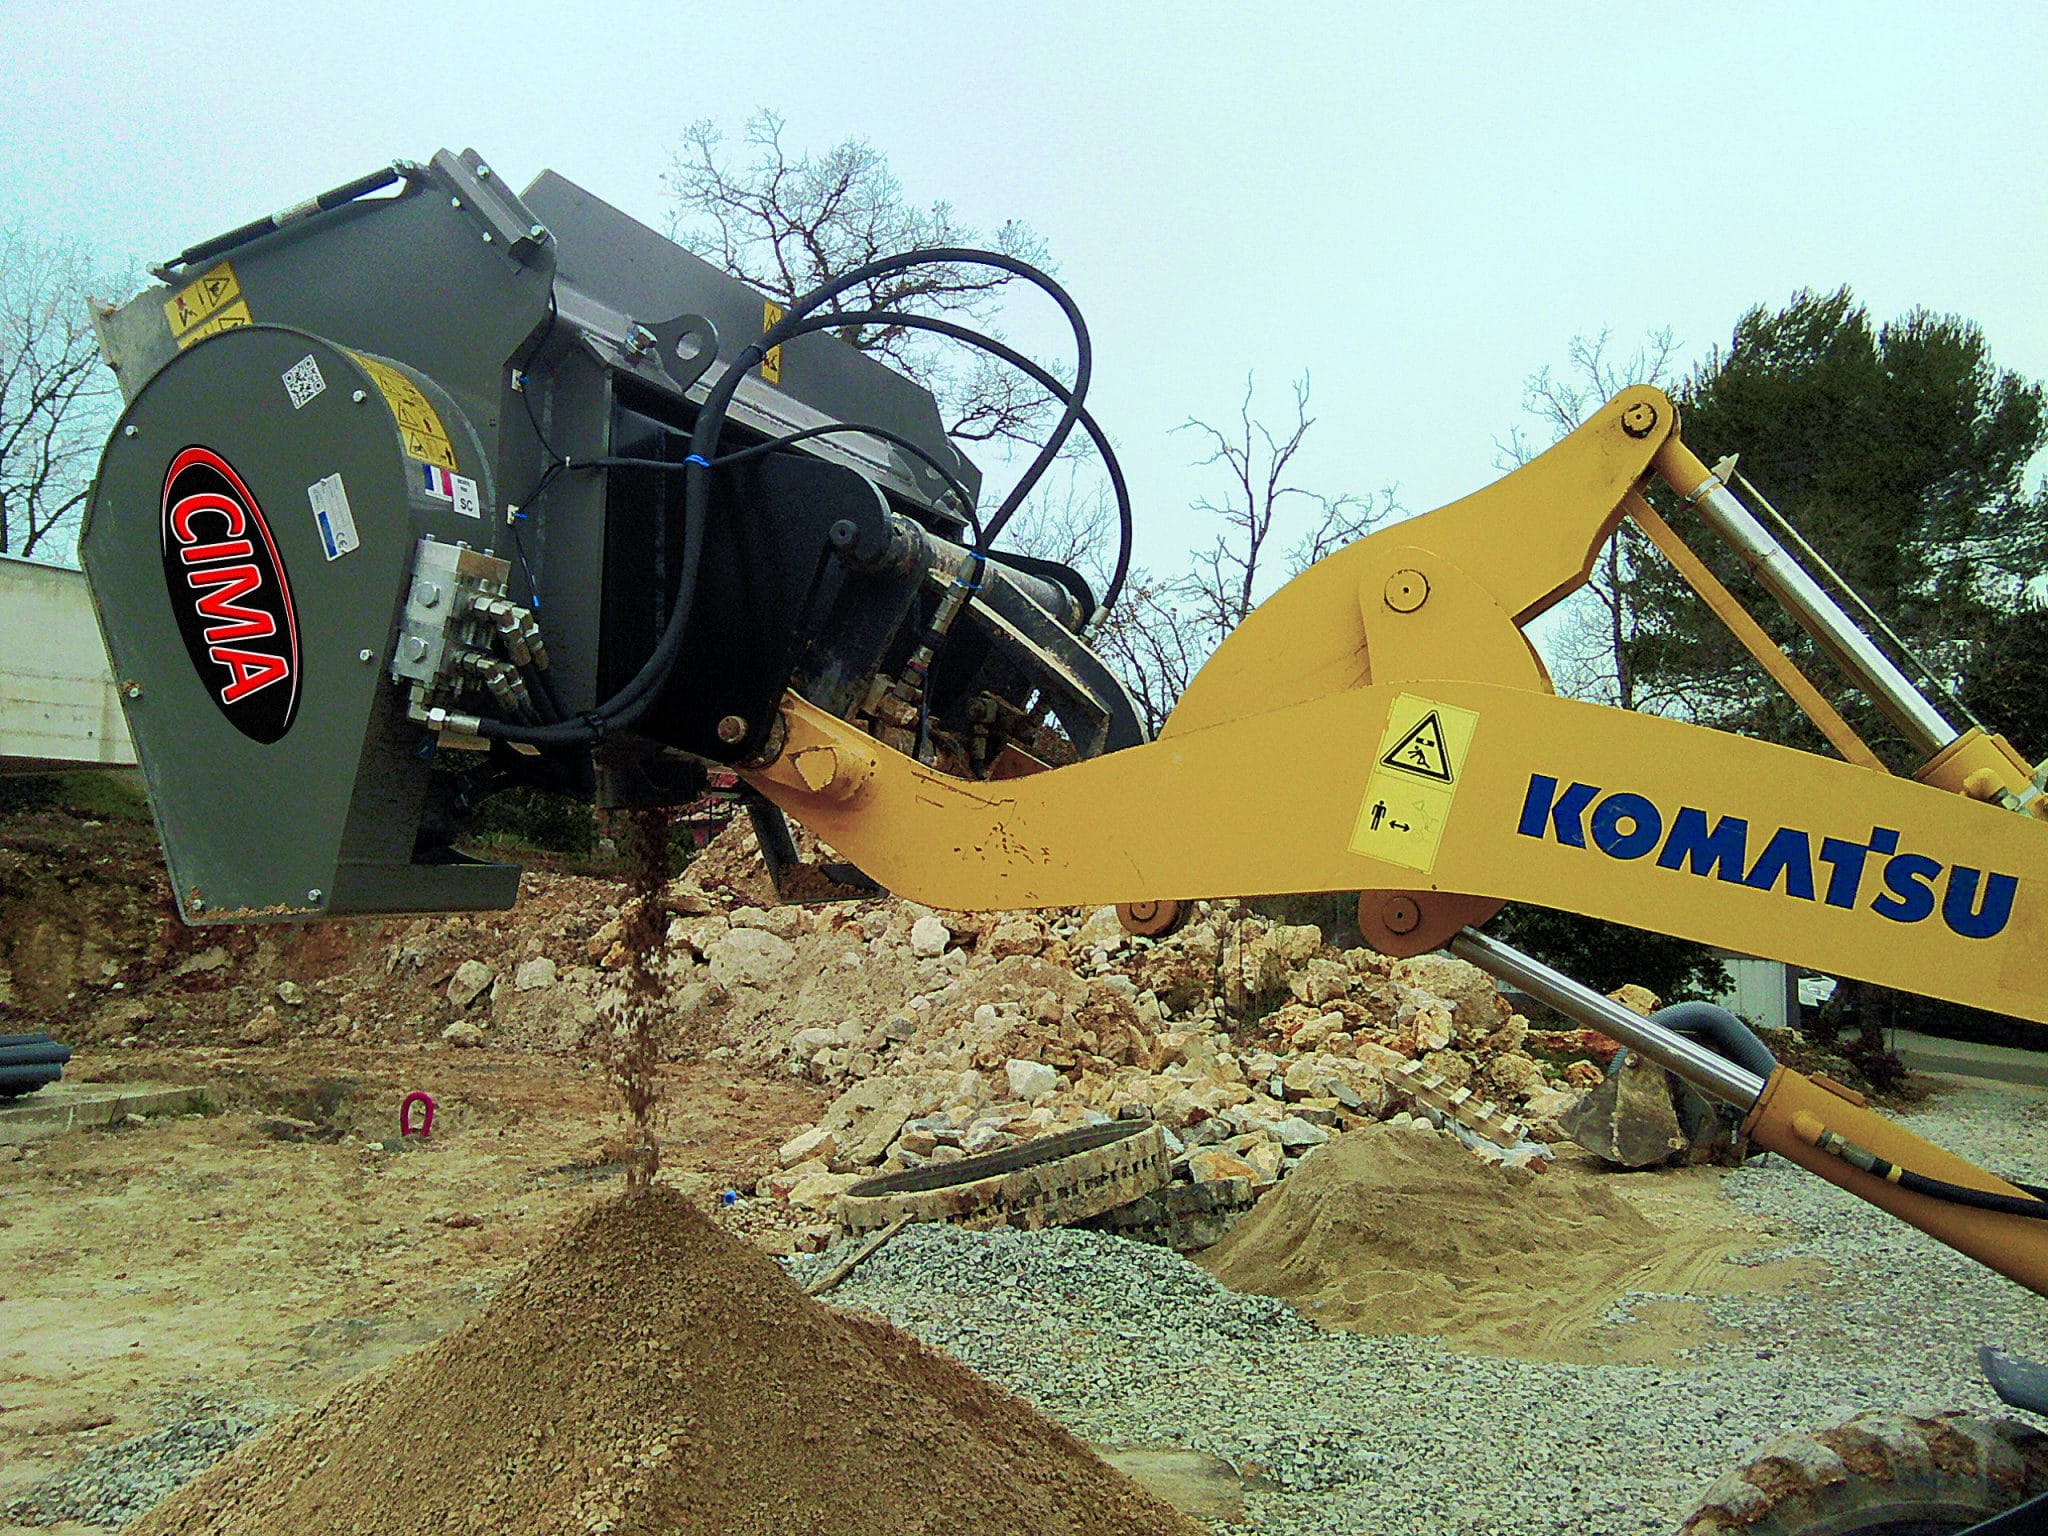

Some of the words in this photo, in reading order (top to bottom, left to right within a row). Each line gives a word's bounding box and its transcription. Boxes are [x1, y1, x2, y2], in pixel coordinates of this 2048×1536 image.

[460, 498, 473, 511] SC
[170, 494, 289, 704] CIMA
[1517, 774, 2019, 939] KOMATSU
